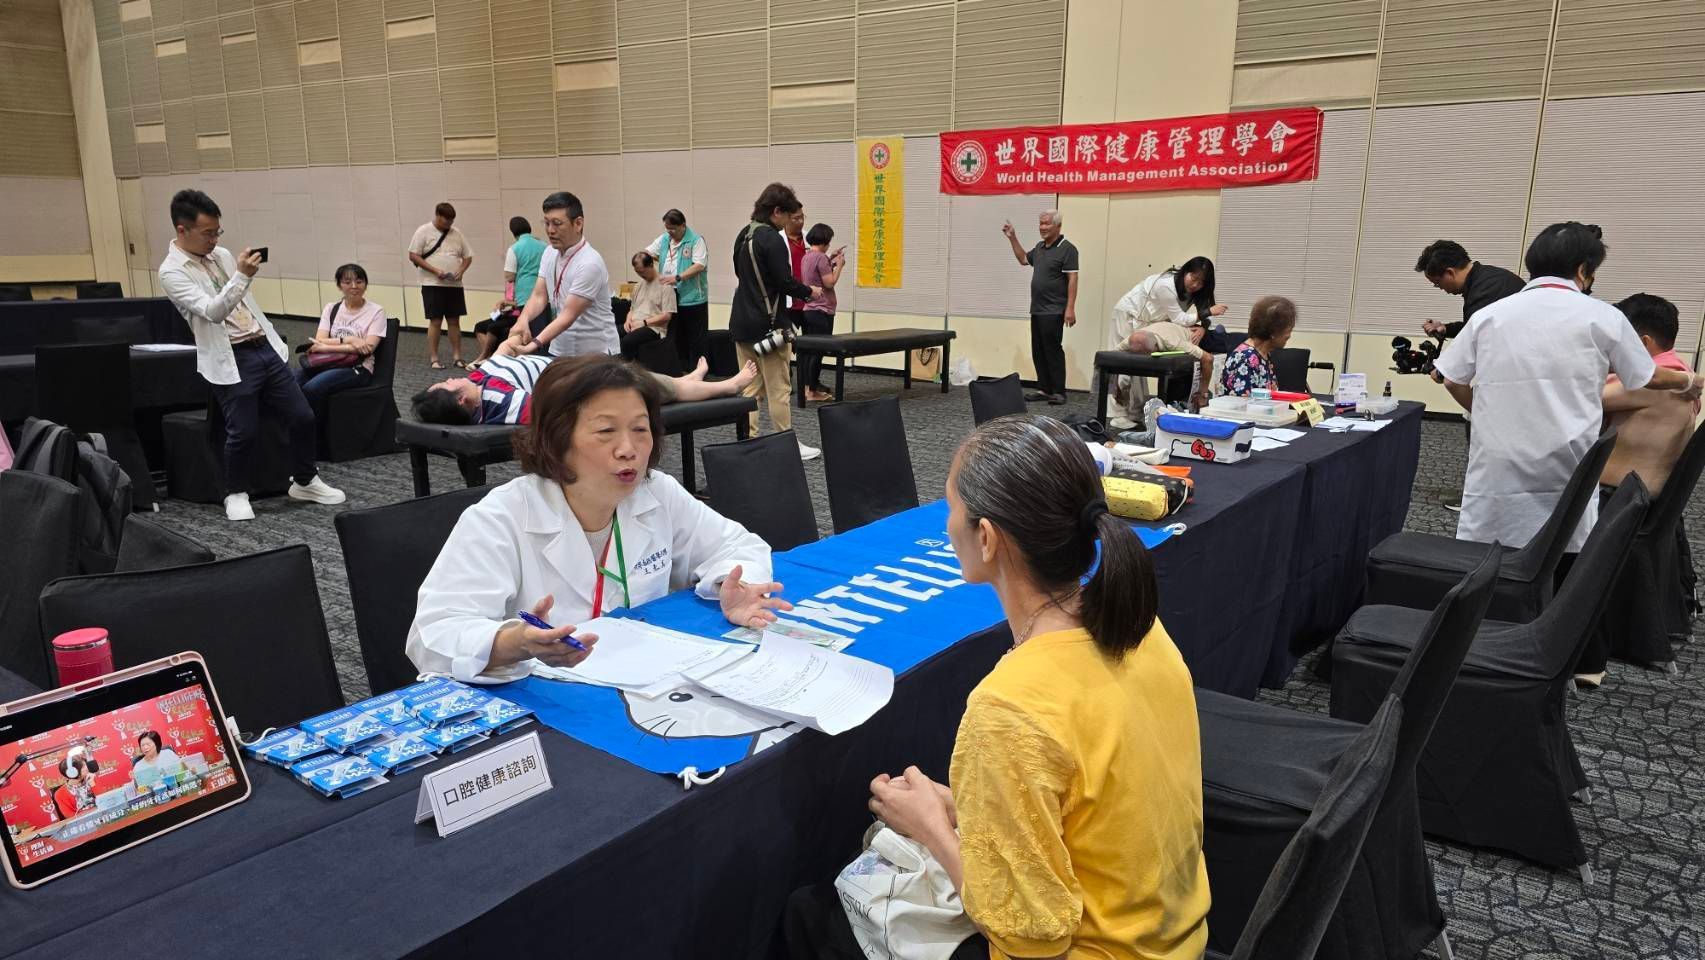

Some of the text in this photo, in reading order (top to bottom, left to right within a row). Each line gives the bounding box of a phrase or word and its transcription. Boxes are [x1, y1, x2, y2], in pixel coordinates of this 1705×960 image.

[994, 120, 1297, 167] 世界國際健康管理學會
[997, 162, 1289, 184] World Health Management Association
[873, 173, 886, 283] 世界國際健康管理學會
[443, 755, 537, 806] 口腔健康諮詢
